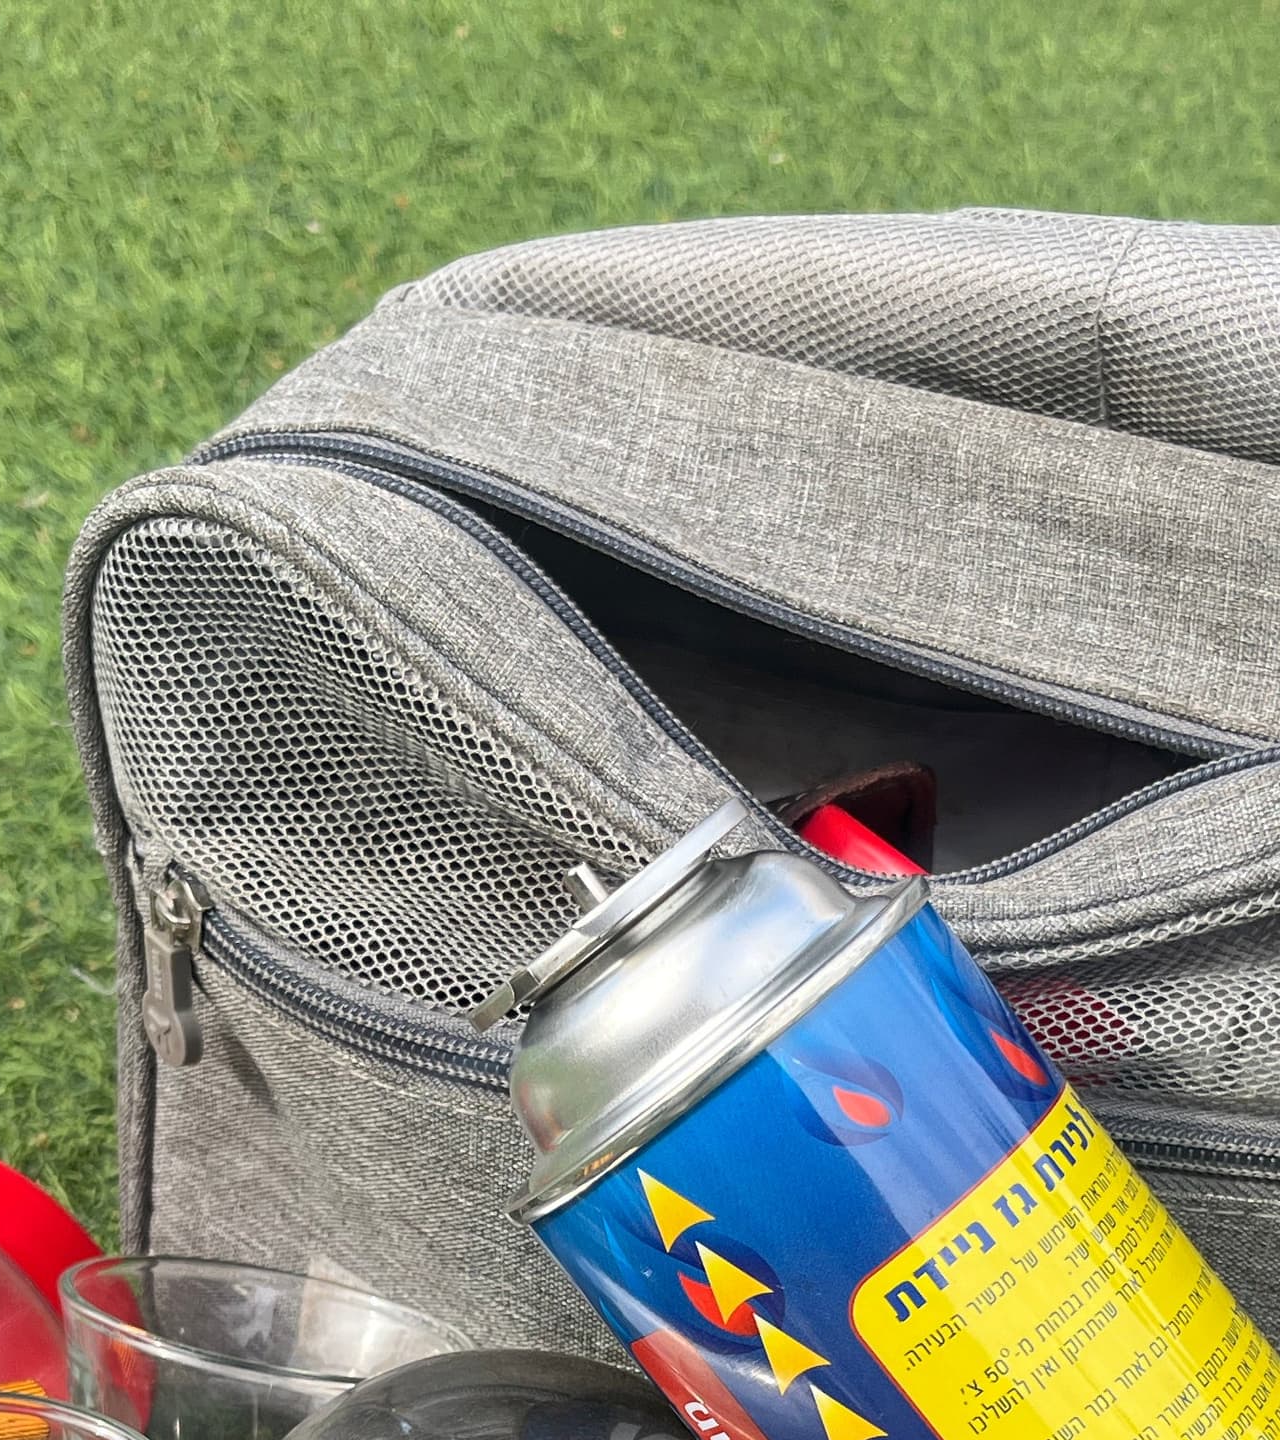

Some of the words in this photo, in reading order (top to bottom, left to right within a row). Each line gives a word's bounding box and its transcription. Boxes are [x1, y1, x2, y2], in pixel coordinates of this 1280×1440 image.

[1031, 1103, 1095, 1192] לכירת
[992, 1182, 1038, 1228] גז
[1079, 1171, 1111, 1212] הוראות
[1111, 1195, 1130, 1216] אור
[1037, 1205, 1084, 1255] השימוש
[1090, 1211, 1117, 1244] שמש
[883, 1221, 997, 1323] ניידת
[1009, 1249, 1039, 1274] של
[1063, 1238, 1091, 1276] ישיר.
[1080, 1226, 1142, 1299] לטמפרטורות
[1136, 1241, 1167, 1275] המיכל
[966, 1271, 1017, 1315] מכשיר
[1115, 1268, 1146, 1303] לאחר
[1187, 1287, 1204, 1310] את
[1034, 1293, 1085, 1343] גבוהות
[1058, 1300, 1118, 1366] שהתרוקן
[1159, 1303, 1195, 1339] המיכל
[903, 1313, 968, 1371] הבעירה.
[1148, 1335, 1169, 1359] גם
[1030, 1355, 1061, 1391] ואין
[1114, 1351, 1153, 1390] לאחר
[1195, 1346, 1228, 1388] במקום
[1236, 1358, 1253, 1382] את
[967, 1378, 1032, 1435] להשליכו
[1084, 1387, 1118, 1417] גמר
[1156, 1382, 1200, 1427] מאוורר
[1221, 1376, 1243, 1401] ברז
[1250, 1382, 1271, 1411] אטם
